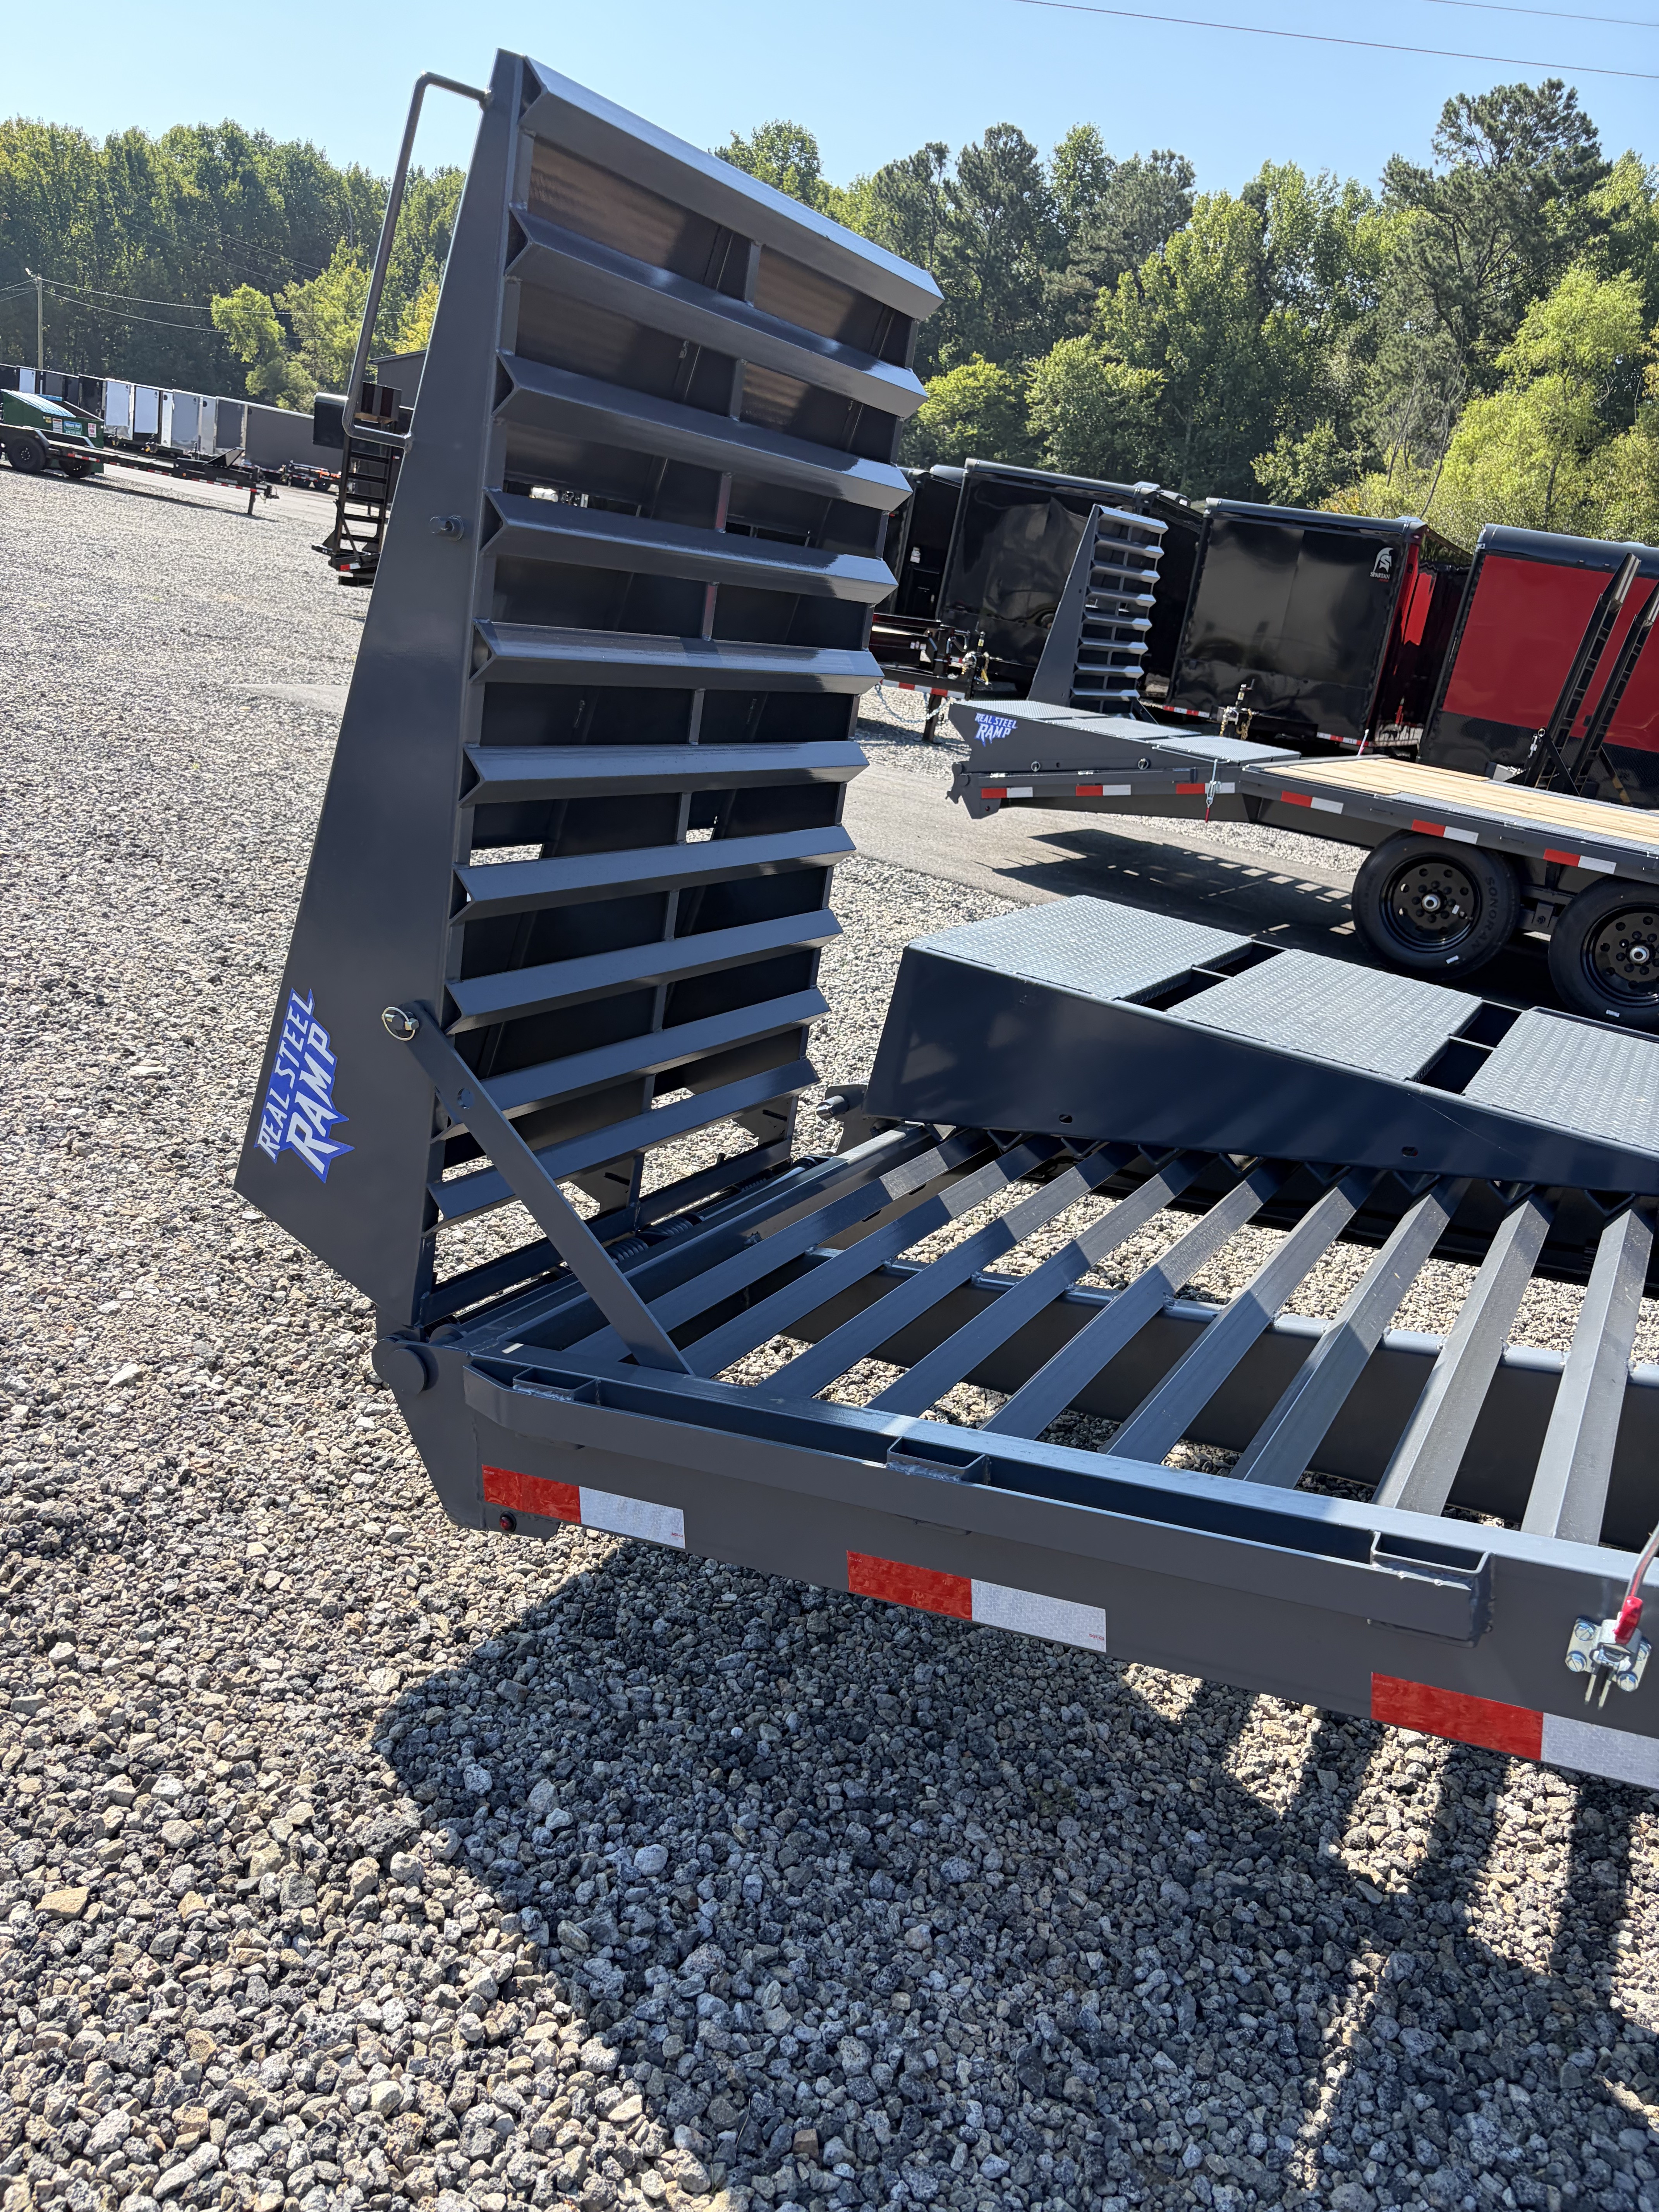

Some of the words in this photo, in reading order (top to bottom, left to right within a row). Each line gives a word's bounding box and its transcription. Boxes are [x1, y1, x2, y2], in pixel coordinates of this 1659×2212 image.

[975, 713, 992, 724] REAL
[993, 716, 1017, 729] STEEL
[976, 723, 1011, 744] RAMP
[1470, 876, 1498, 951] SONORAN
[257, 1088, 290, 1159] REAL
[275, 993, 313, 1089] STEEL
[286, 1022, 340, 1175] RAMP
